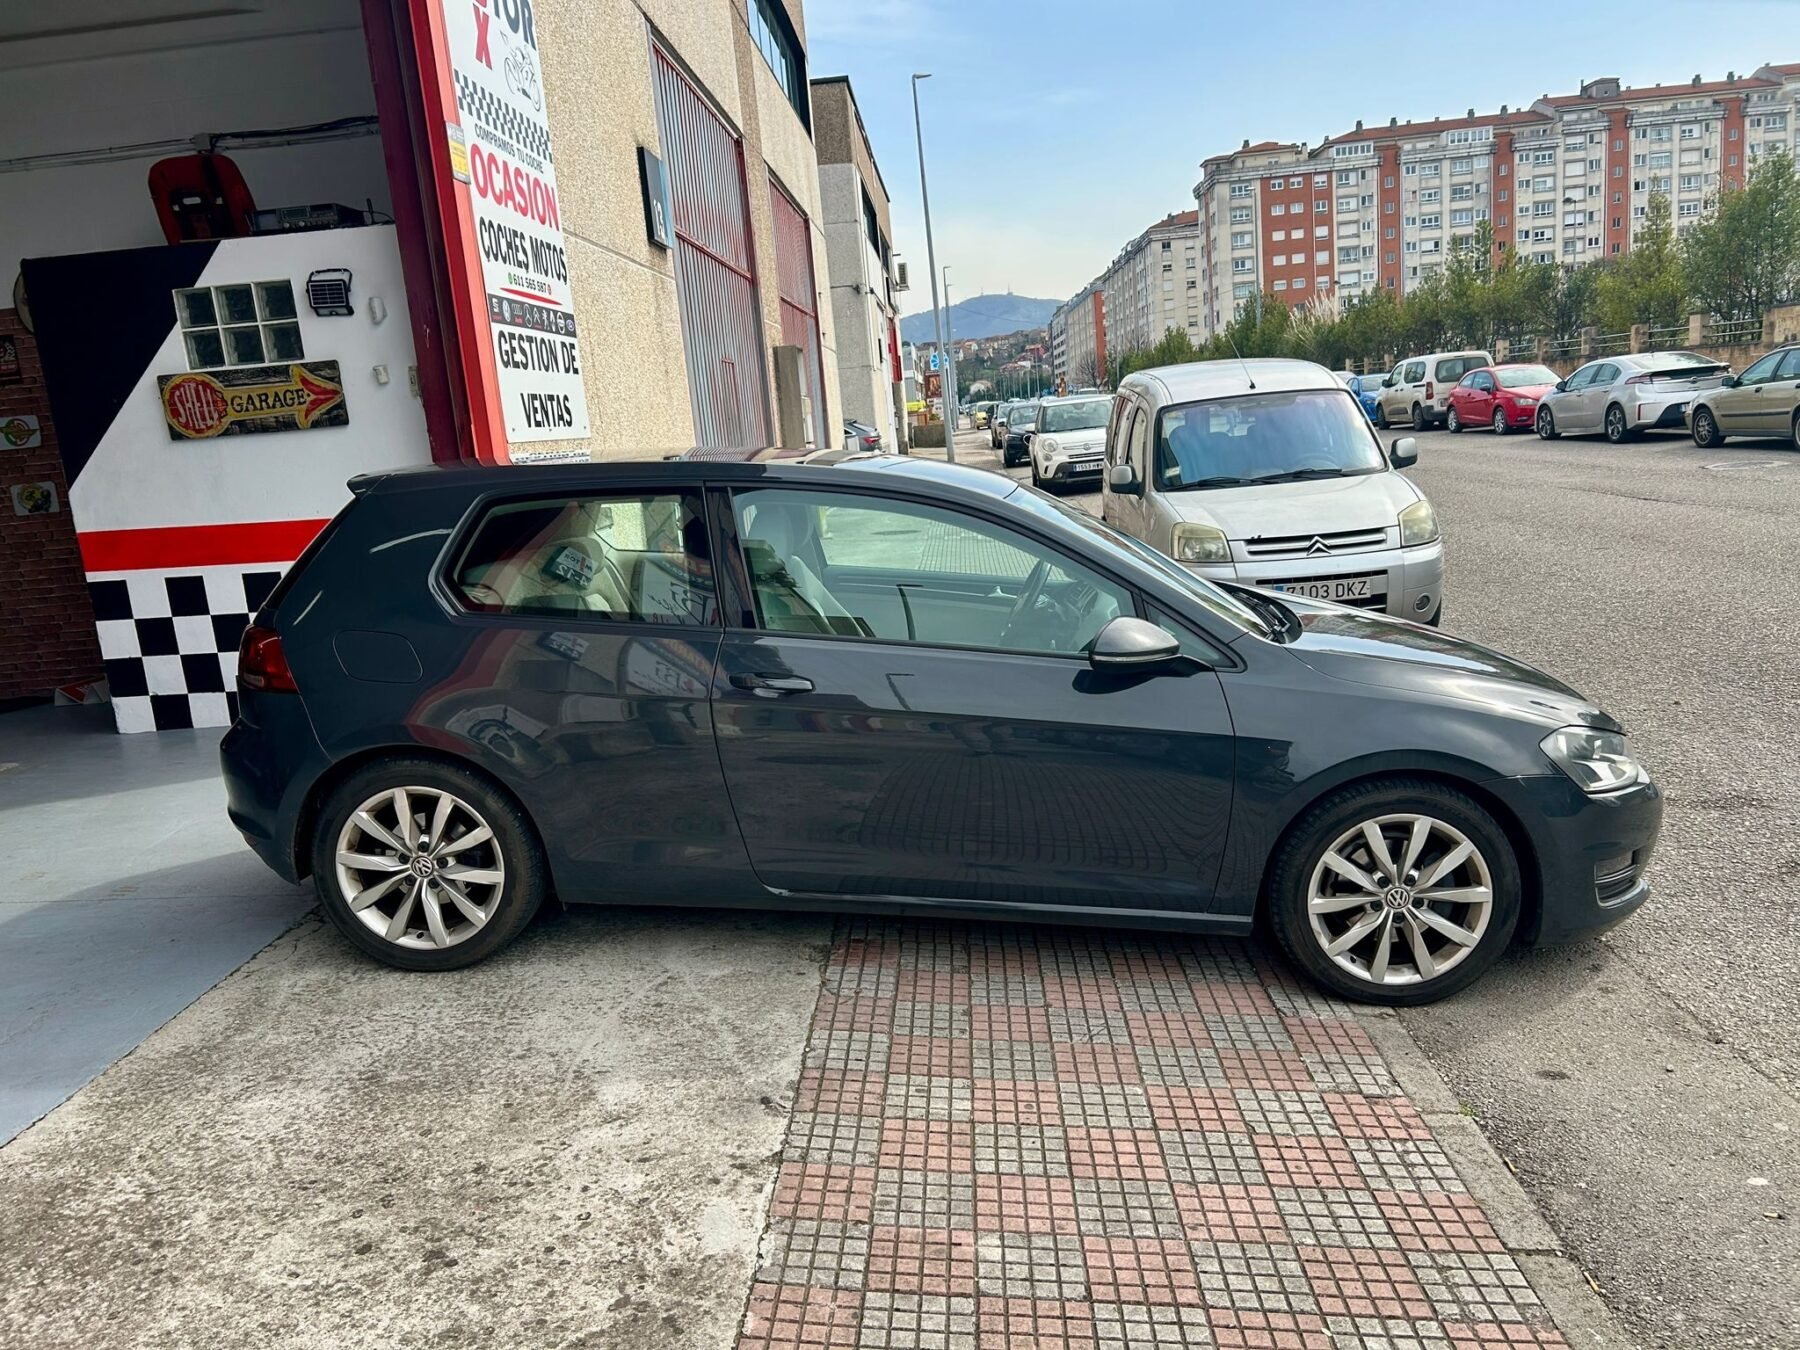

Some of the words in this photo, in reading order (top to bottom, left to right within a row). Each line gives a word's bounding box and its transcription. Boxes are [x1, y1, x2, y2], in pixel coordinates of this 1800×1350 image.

[472, 0, 492, 71] X
[474, 123, 515, 158] COMPRAMOS
[516, 147, 525, 163] TU
[525, 153, 544, 175] COCHE
[470, 143, 560, 232] OCASION
[479, 216, 529, 274] COCHES
[529, 235, 568, 286] MOTOS
[498, 330, 560, 374] GESTION
[561, 341, 579, 375] DE
[174, 382, 218, 430] SHELL
[230, 388, 307, 414] GARAGE
[520, 392, 573, 428] VENTAS
[1286, 585, 1330, 599] 7103
[1335, 581, 1368, 598] DKZ
